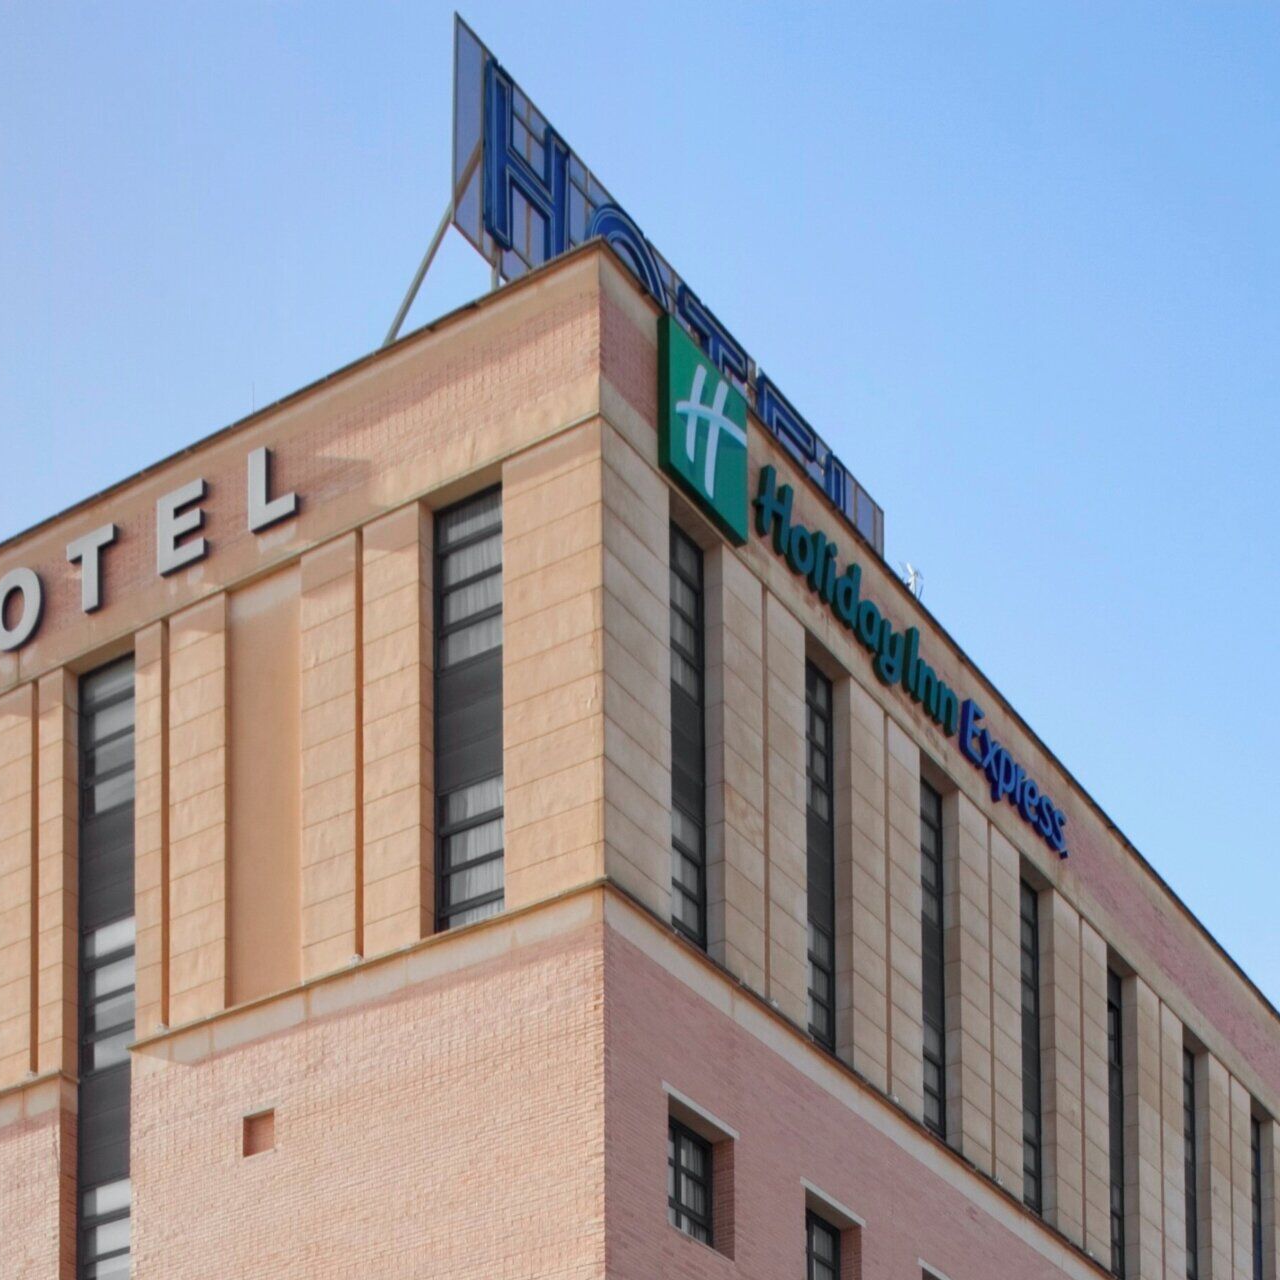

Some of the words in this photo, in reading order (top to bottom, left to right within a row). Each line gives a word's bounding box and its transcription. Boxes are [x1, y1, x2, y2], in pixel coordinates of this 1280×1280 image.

[753, 463, 905, 687] Holiday
[901, 625, 959, 738] Inn
[959, 698, 1067, 852] Express
